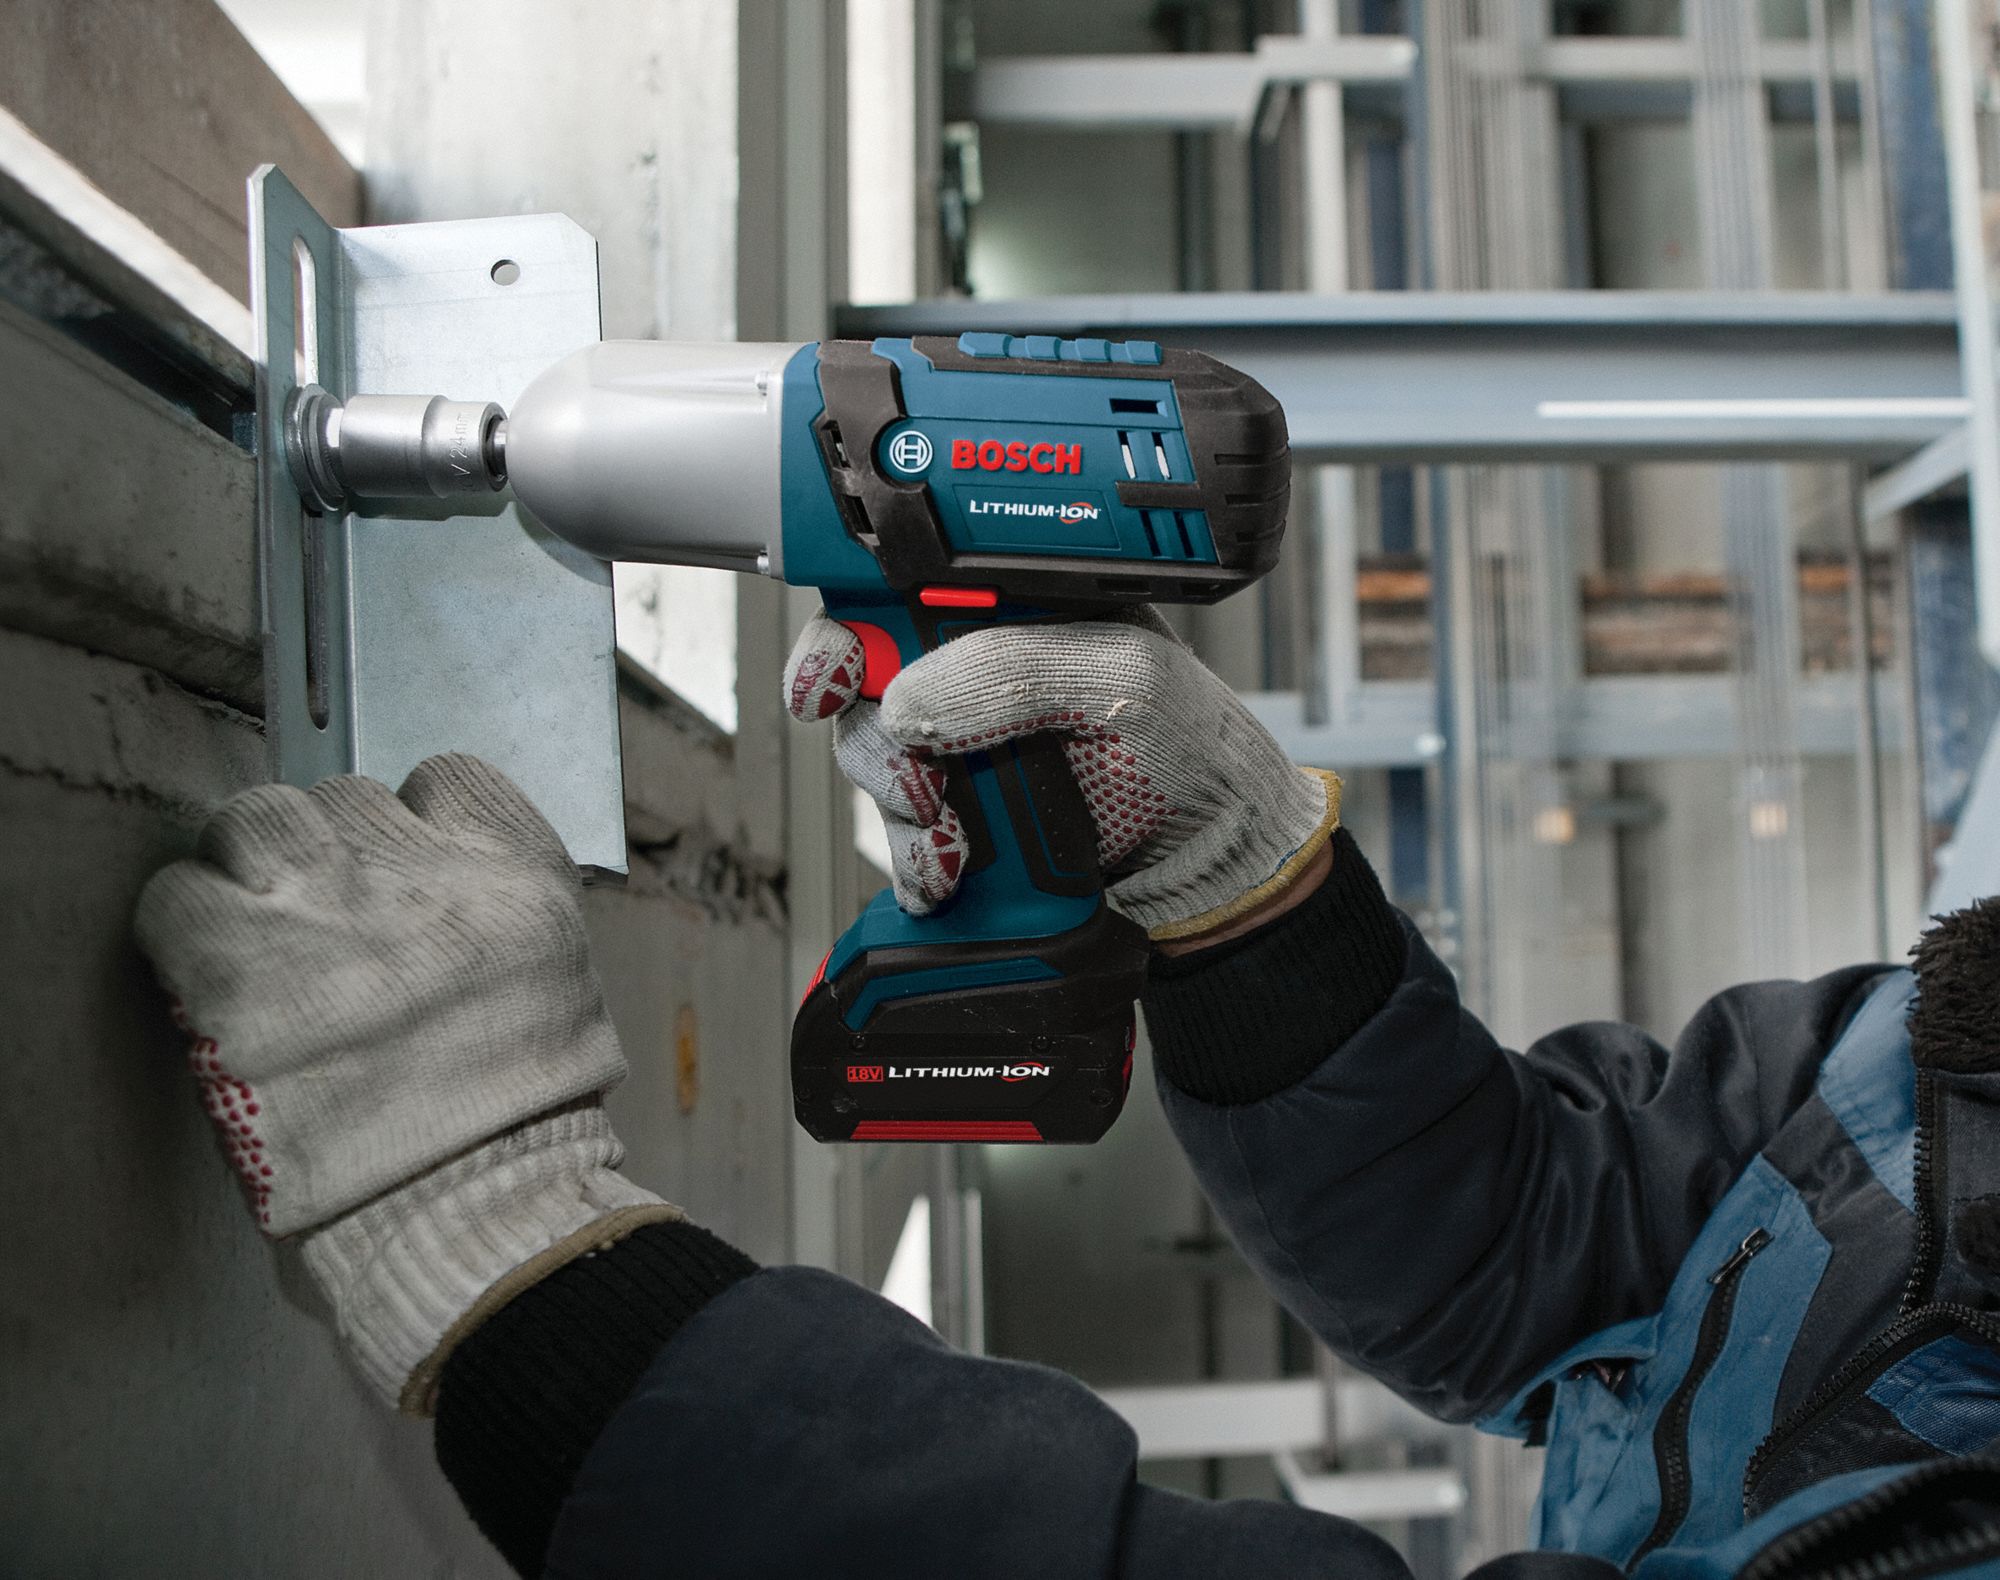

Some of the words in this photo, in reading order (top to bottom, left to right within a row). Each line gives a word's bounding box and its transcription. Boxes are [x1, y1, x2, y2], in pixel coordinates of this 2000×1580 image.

[952, 439, 1081, 474] BOSCH
[970, 499, 1099, 522] LITHIUM-ION
[848, 1066, 883, 1082] 18V
[888, 1064, 1050, 1080] LITHIUM-ION
